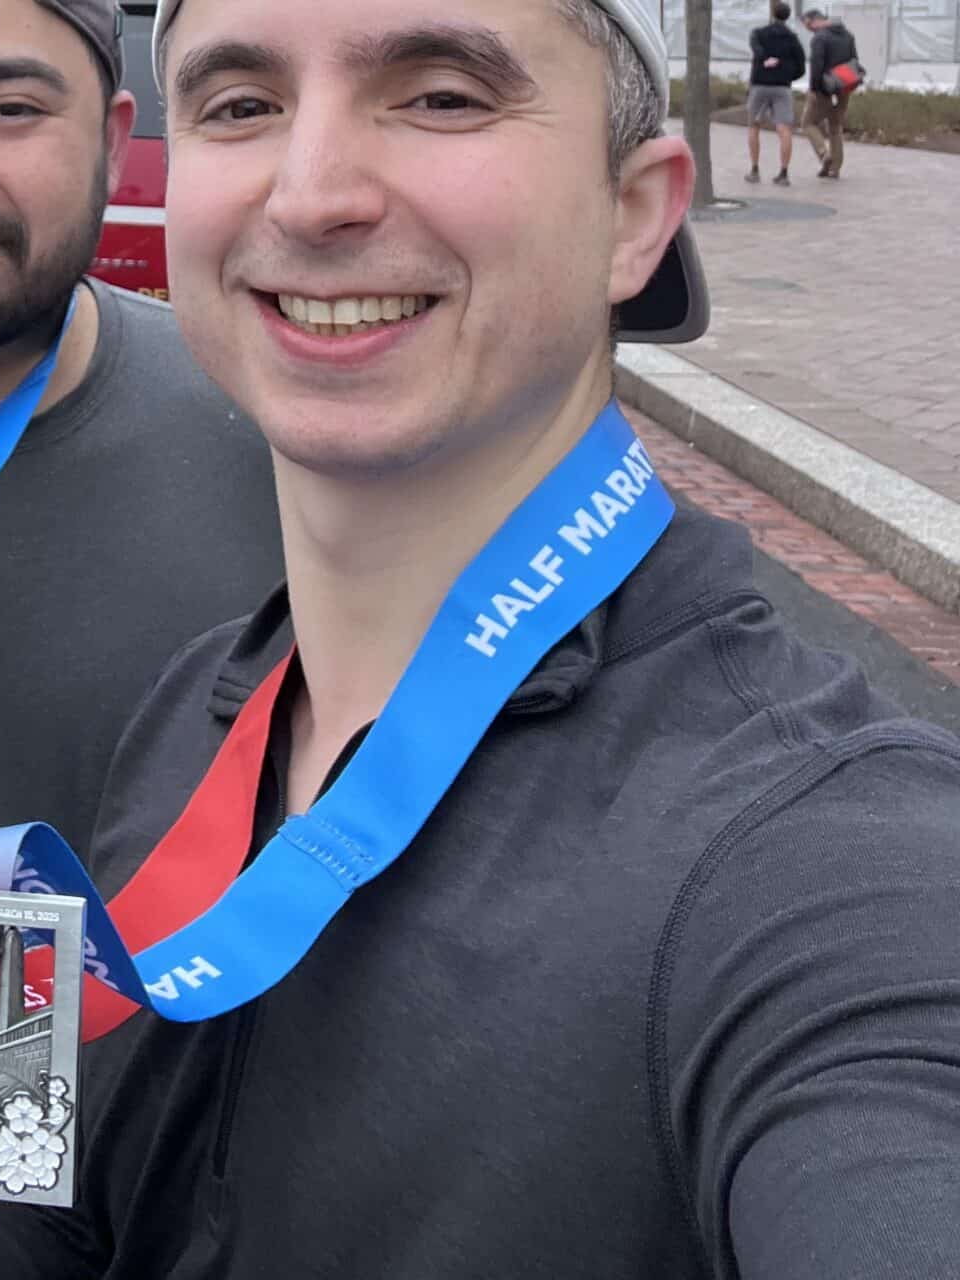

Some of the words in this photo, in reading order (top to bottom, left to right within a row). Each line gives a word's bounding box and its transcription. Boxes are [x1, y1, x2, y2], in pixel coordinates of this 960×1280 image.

[464, 544, 565, 658] HALF
[557, 437, 654, 556] MARAT
[144, 956, 223, 1000] HA
